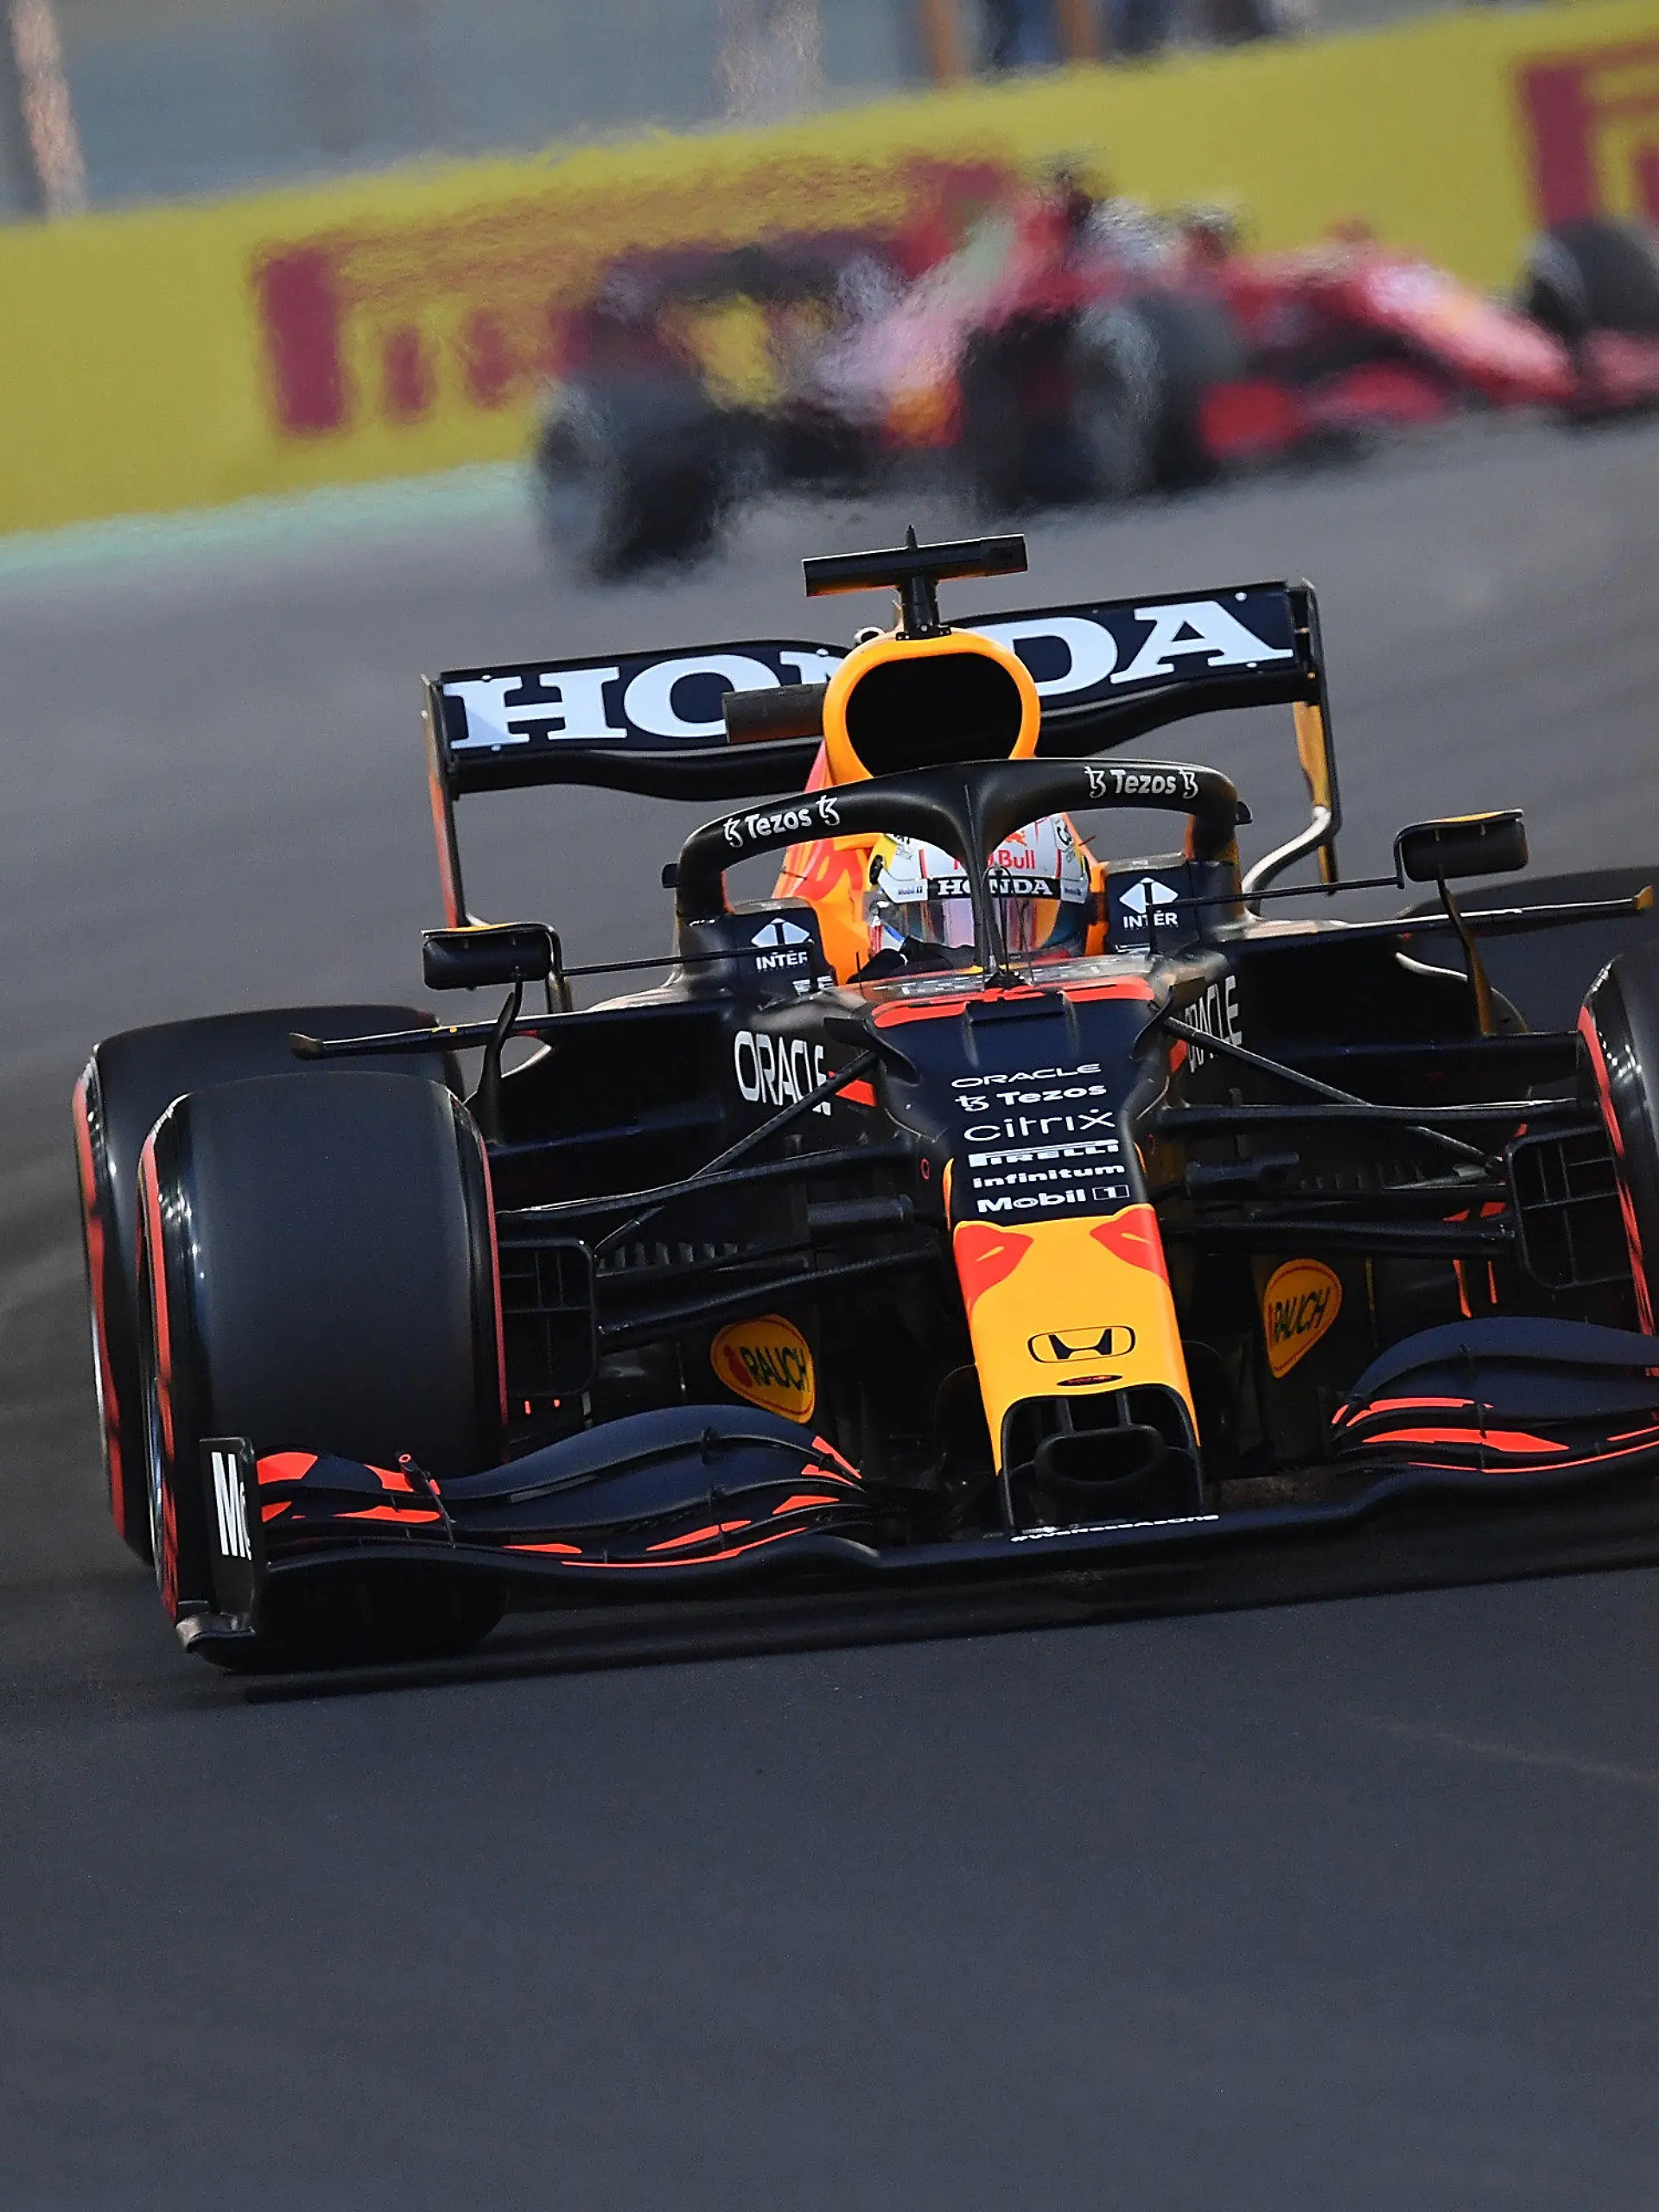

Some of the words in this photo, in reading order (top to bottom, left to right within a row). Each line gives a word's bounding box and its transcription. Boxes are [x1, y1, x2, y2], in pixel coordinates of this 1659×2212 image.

[1110, 769, 1176, 794] Tezos
[745, 809, 812, 838] Tezos
[999, 849, 1035, 869] Bull
[951, 1063, 1102, 1088] ORACLE
[996, 1085, 1107, 1105] Tezos
[968, 1139, 1119, 1166] PIRELLI
[973, 1165, 1125, 1188] infinitum
[977, 1188, 1086, 1213] Mobil
[740, 1346, 810, 1393] RAUCH
